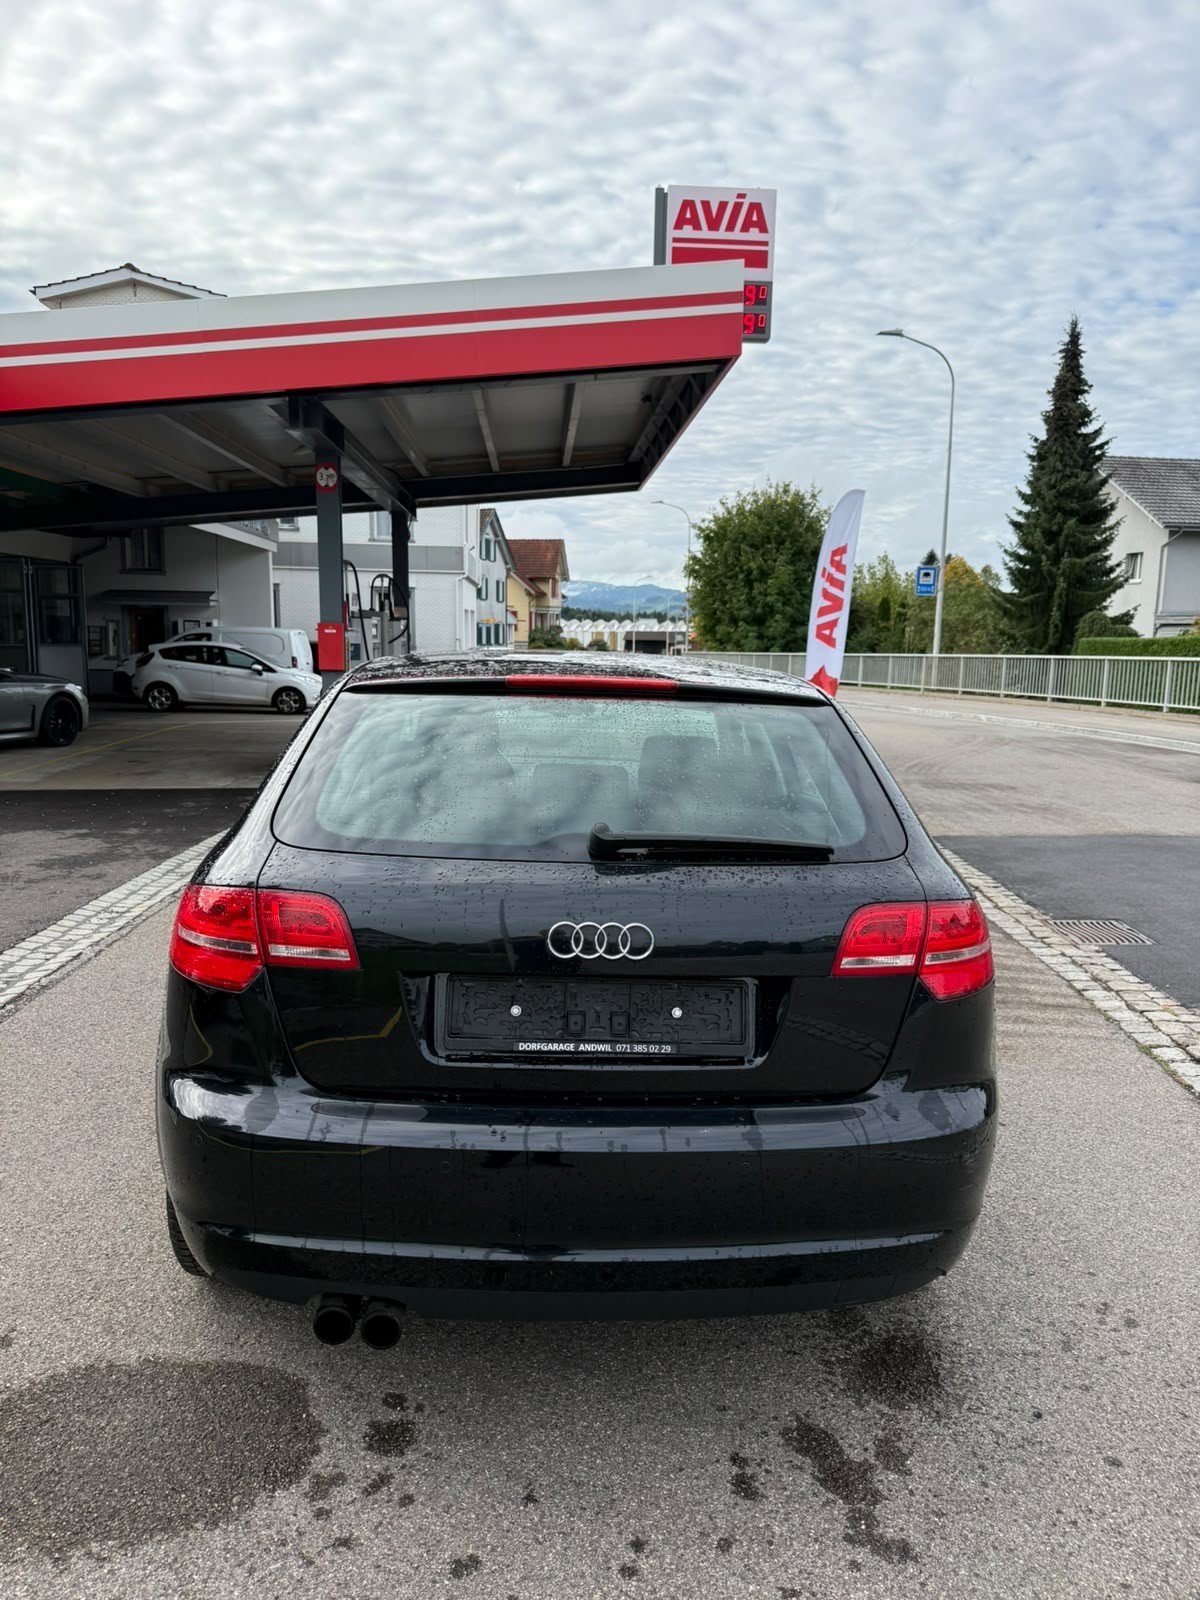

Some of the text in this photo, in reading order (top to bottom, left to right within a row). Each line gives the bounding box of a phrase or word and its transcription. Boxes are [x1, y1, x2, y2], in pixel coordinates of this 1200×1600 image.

[518, 1042, 671, 1053] DORFGARAGE ANDWIL 071 385 02 29
